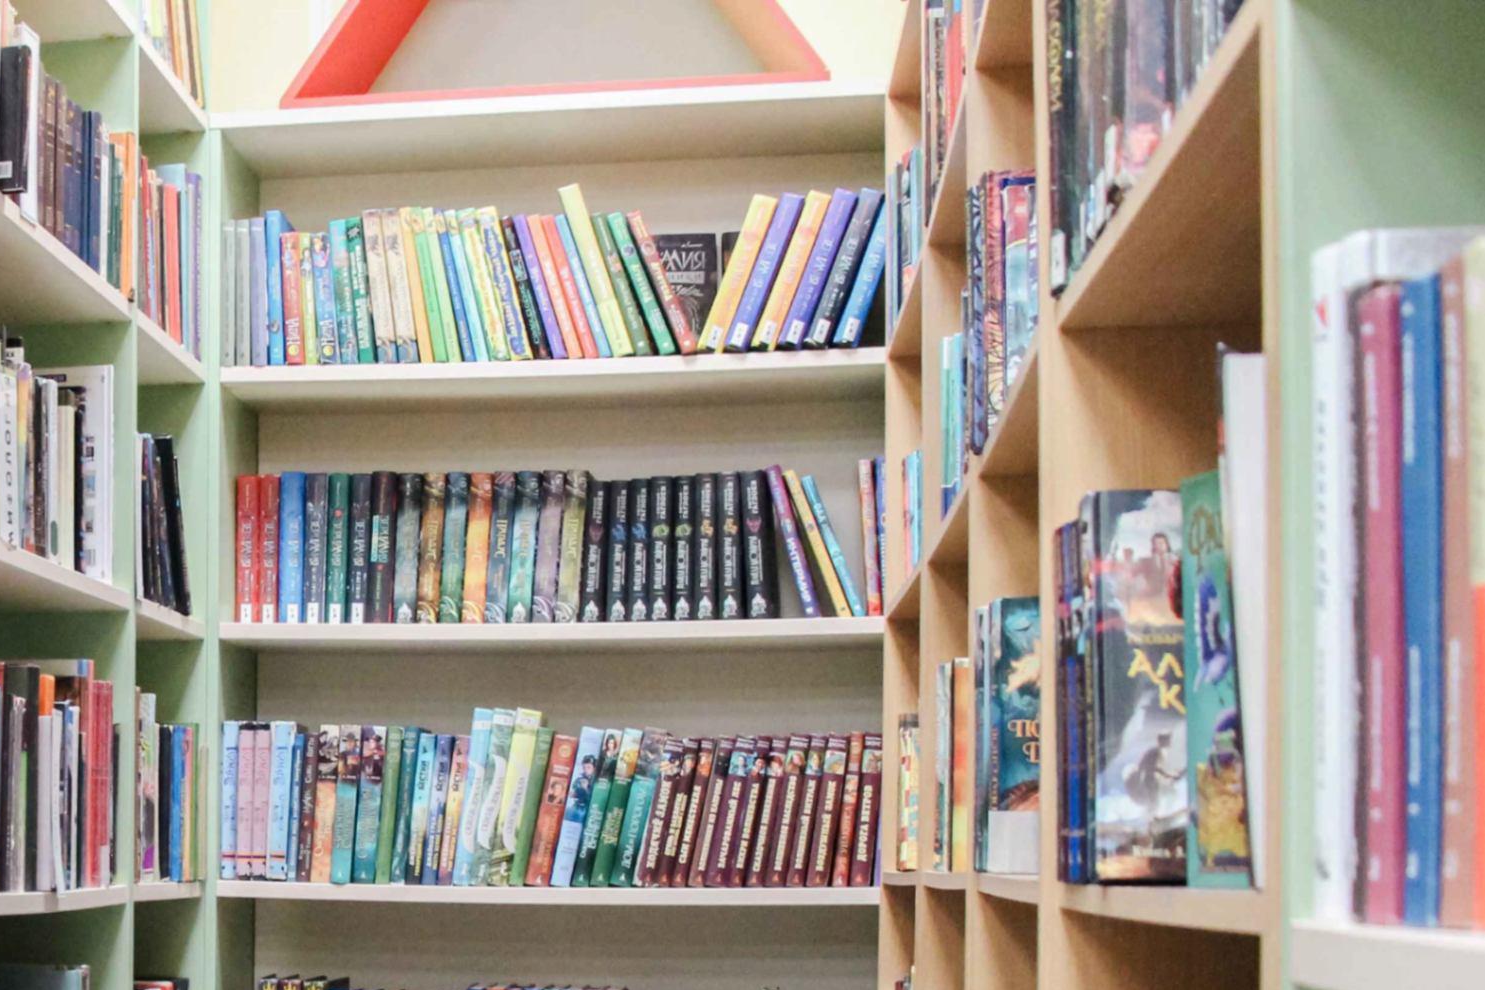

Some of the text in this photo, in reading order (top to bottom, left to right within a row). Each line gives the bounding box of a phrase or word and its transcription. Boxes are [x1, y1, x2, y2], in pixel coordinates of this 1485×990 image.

[787, 537, 811, 602] ИНТЕРМИР
[655, 781, 672, 817] ЗАМОК
[857, 785, 872, 861] ДОРОГА ВЕТРОВ
